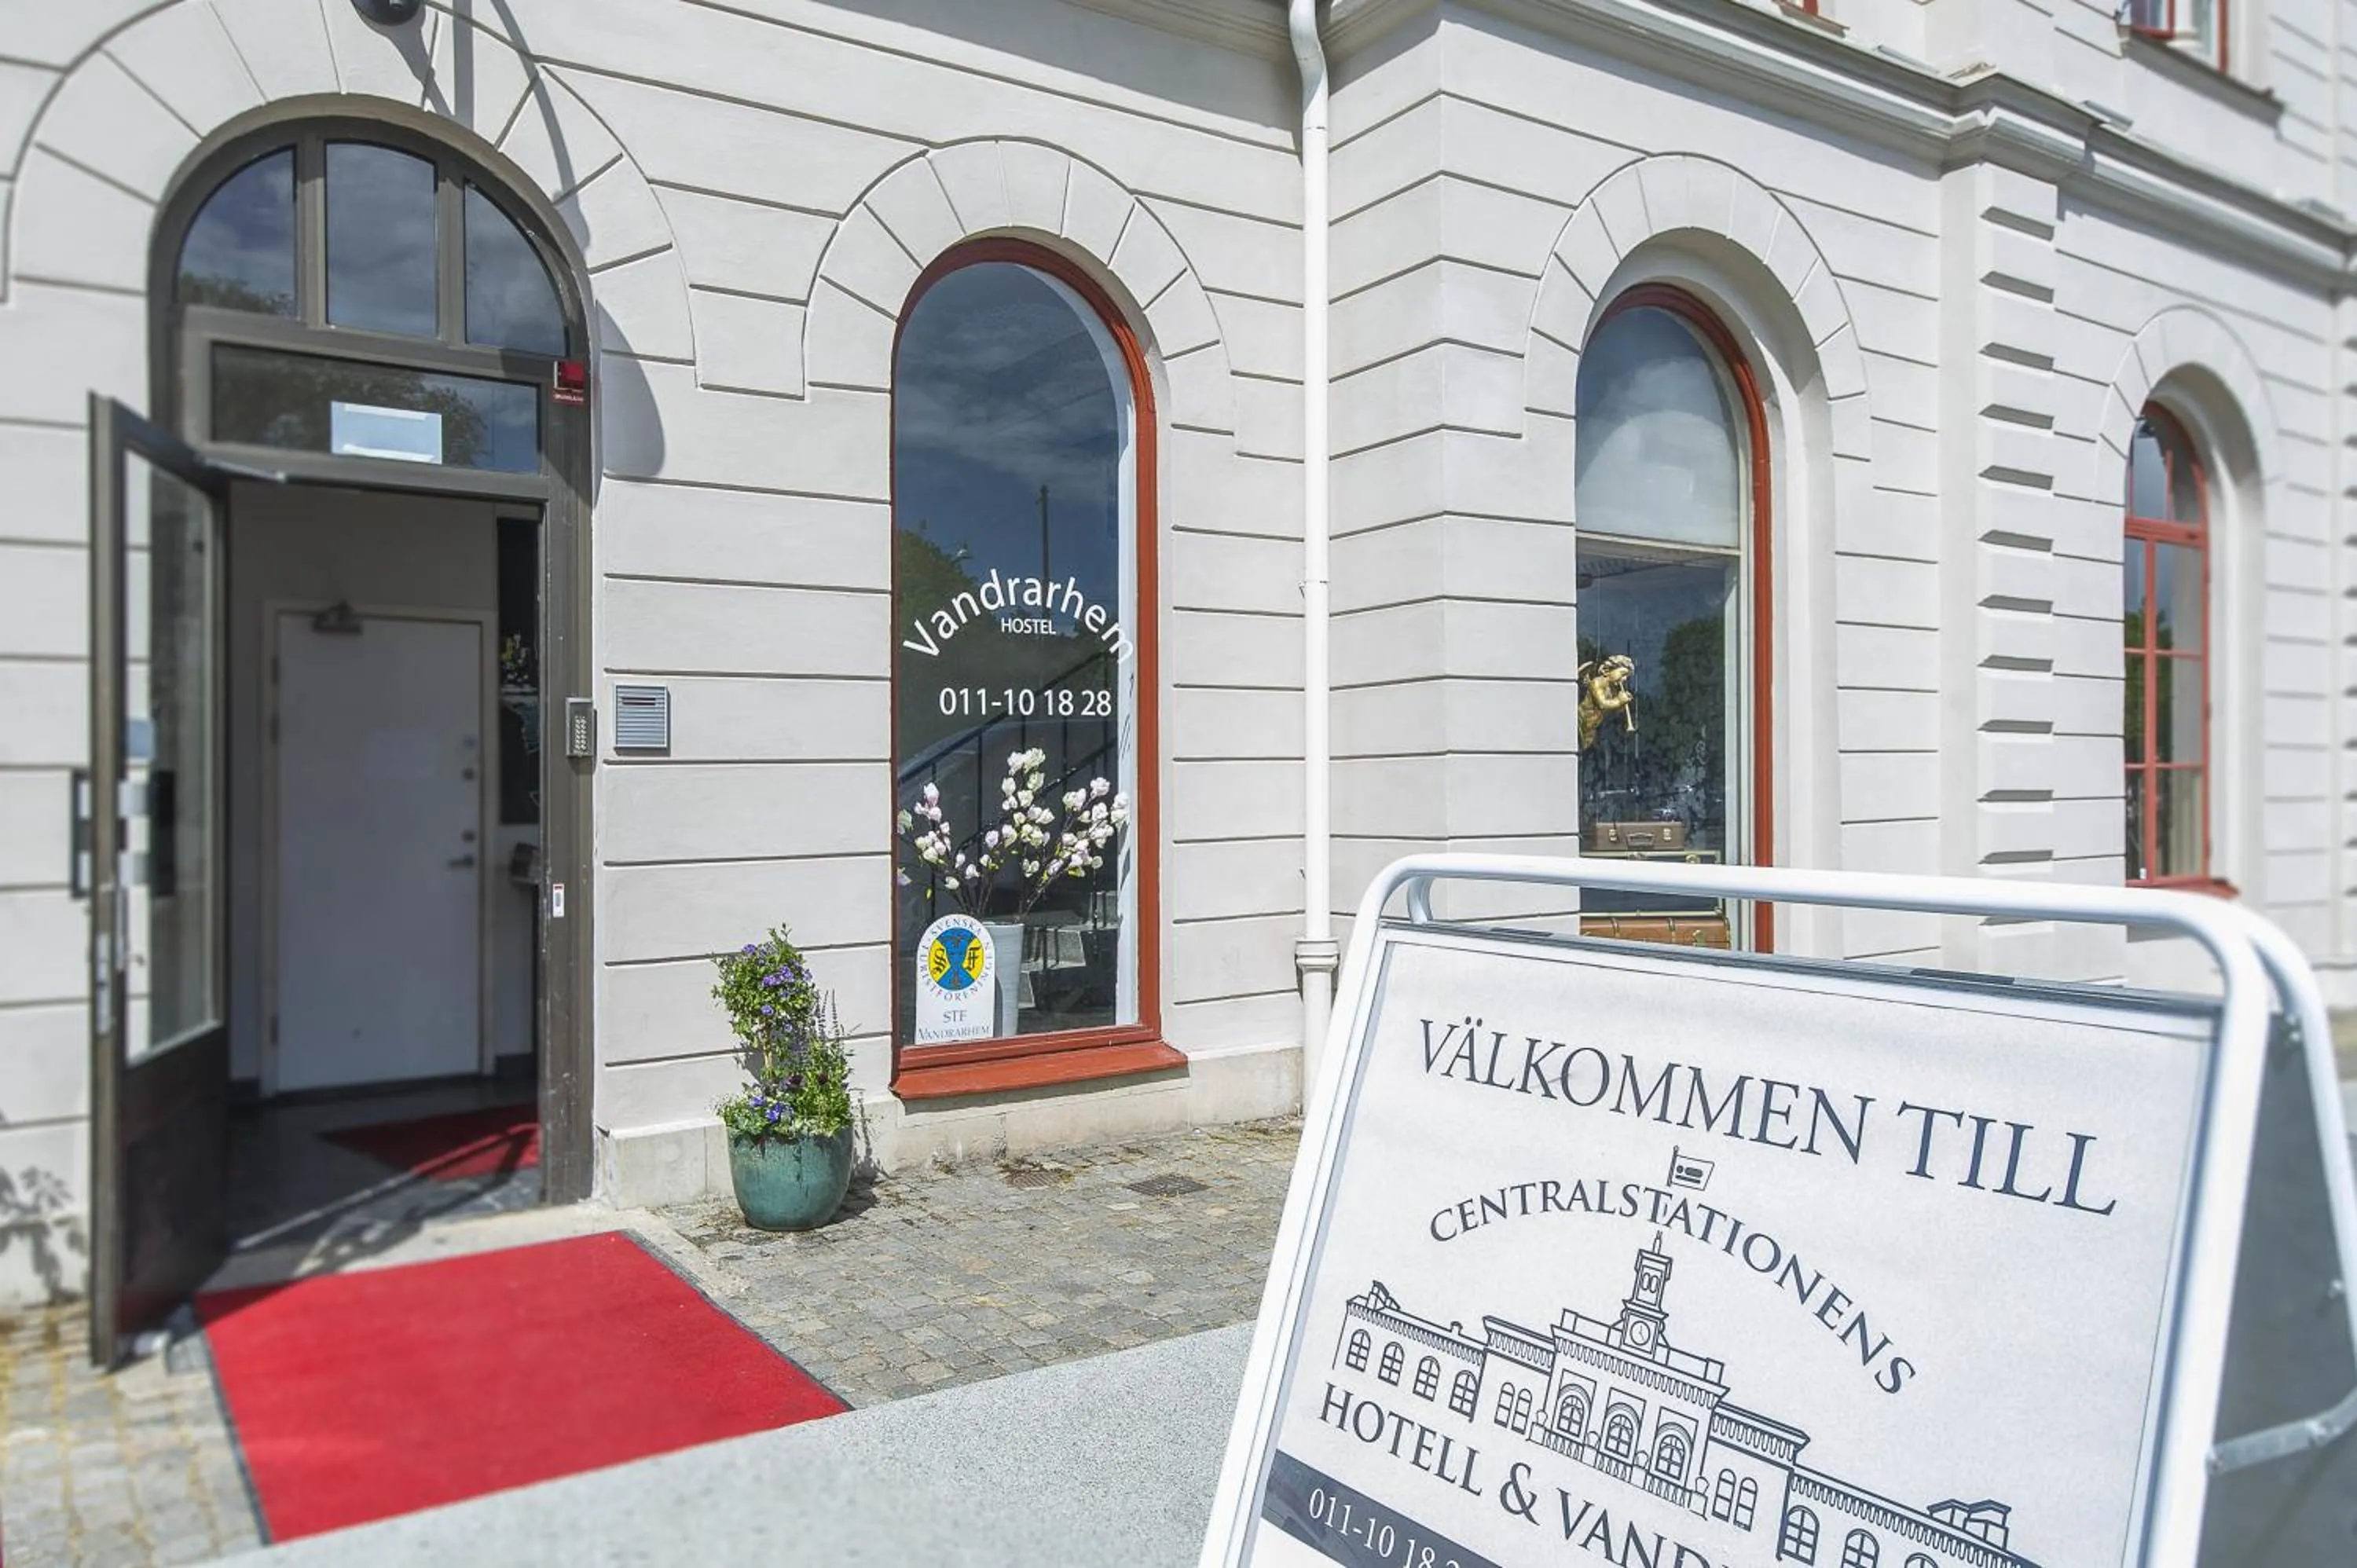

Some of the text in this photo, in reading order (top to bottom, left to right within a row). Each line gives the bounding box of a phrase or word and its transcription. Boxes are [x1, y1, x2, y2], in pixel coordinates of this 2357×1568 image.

[904, 569, 1134, 664] Vandrarhem
[1001, 618, 1057, 635] HOSTEL
[939, 687, 1112, 716] 011-10 18 28
[943, 1009, 968, 1024] STF
[1420, 1016, 2118, 1217] VÄLKOMMEN TILL
[1430, 1179, 1916, 1394] CENTRALSTATIONENS
[1318, 1383, 1729, 1568] HOTELL & VAND
[1309, 1488, 1395, 1558] 011-10
